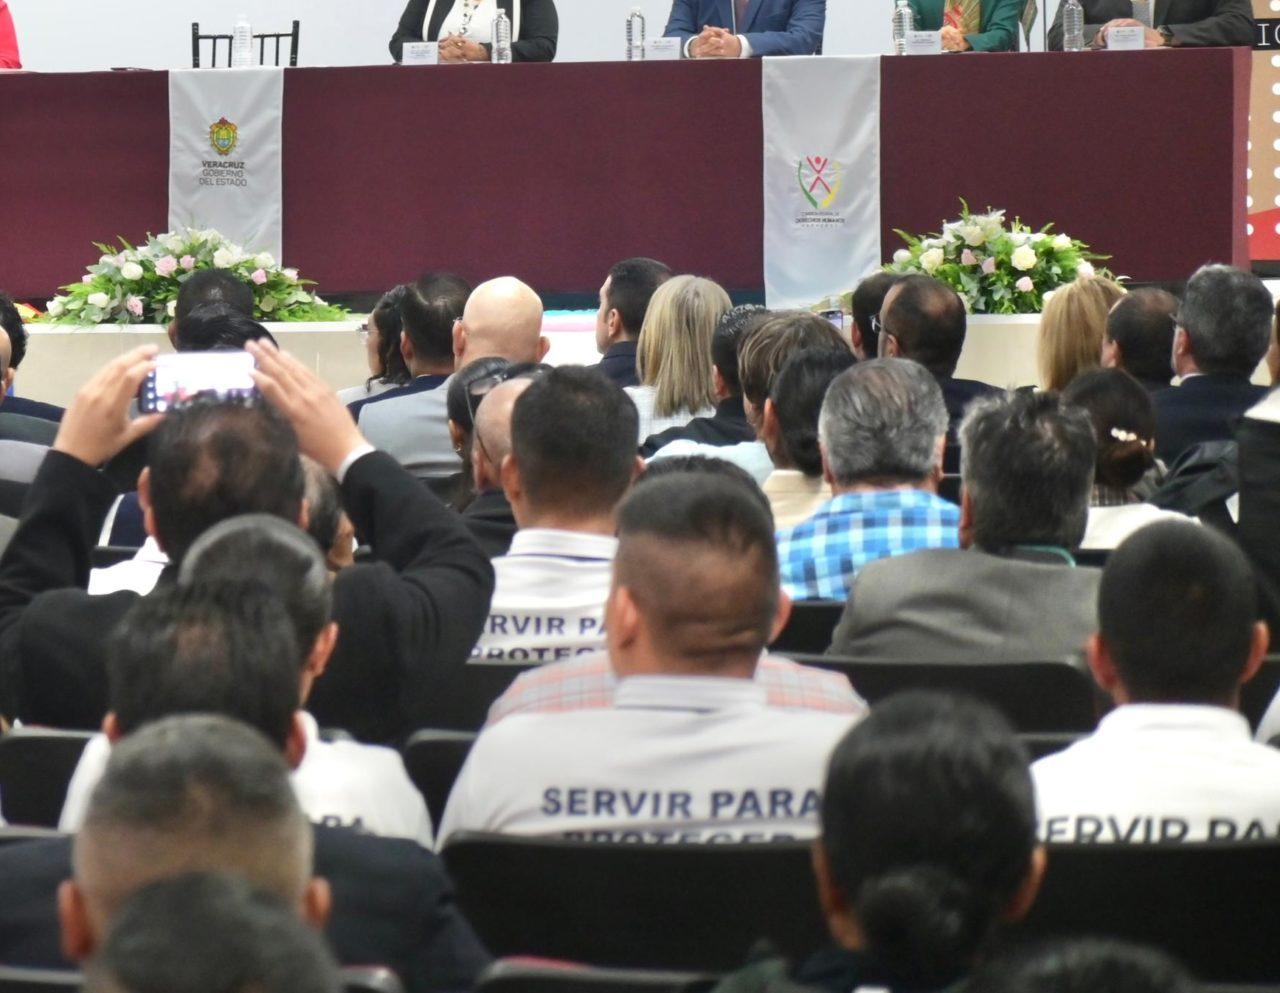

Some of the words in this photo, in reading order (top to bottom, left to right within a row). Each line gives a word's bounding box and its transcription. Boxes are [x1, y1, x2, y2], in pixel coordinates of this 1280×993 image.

[202, 161, 245, 169] VERACRUZ
[202, 169, 244, 177] GOBIERNO
[199, 178, 215, 186] DEL
[216, 178, 248, 187] ESTADO
[489, 614, 565, 635] RVIR
[542, 788, 692, 817] SERVIR
[710, 789, 821, 819] PARA
[1045, 816, 1190, 844] ERVIR
